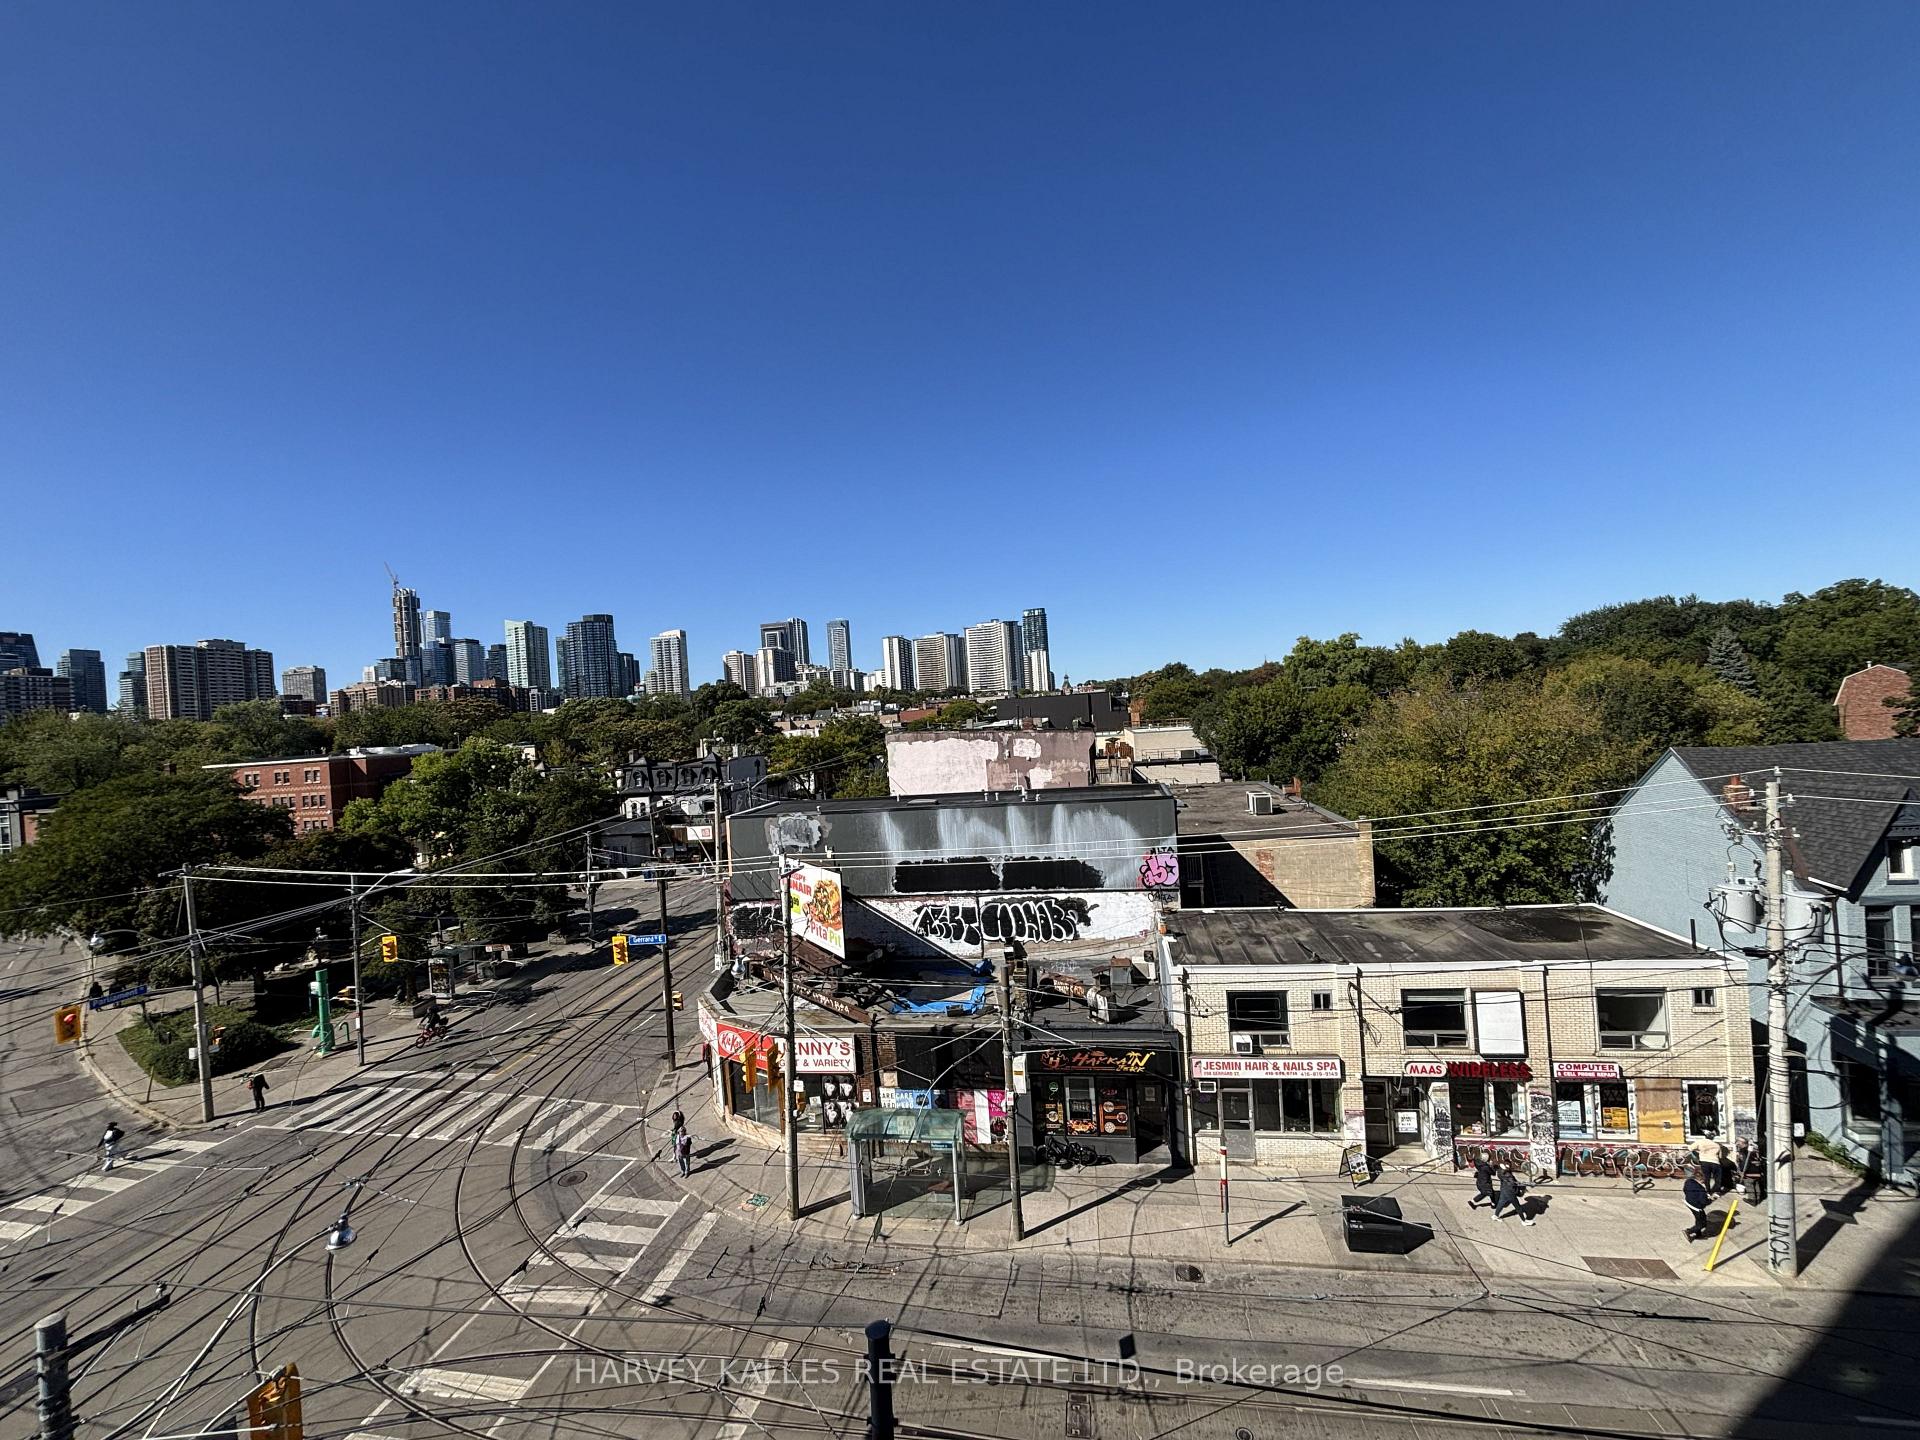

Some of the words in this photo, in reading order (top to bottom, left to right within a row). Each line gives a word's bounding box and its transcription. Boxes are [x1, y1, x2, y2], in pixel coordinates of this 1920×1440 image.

[790, 879, 812, 897] NAIR
[810, 919, 828, 941] Pita
[829, 929, 842, 948] Pit
[92, 988, 138, 1008] Parliament
[779, 1041, 851, 1056] JNNY'S
[780, 1059, 799, 1067] GT
[803, 1059, 809, 1067] &
[813, 1059, 851, 1067] VARIETY
[1203, 1061, 1242, 1071] JESMIN
[1245, 1061, 1269, 1071] HAIR
[1272, 1061, 1280, 1071] &
[1283, 1061, 1314, 1071] NAILS
[1317, 1061, 1338, 1071] SPA
[1409, 1065, 1442, 1075] MAAS
[1447, 1061, 1532, 1080] WIRELESS
[1558, 1063, 1615, 1071] COMPUTER
